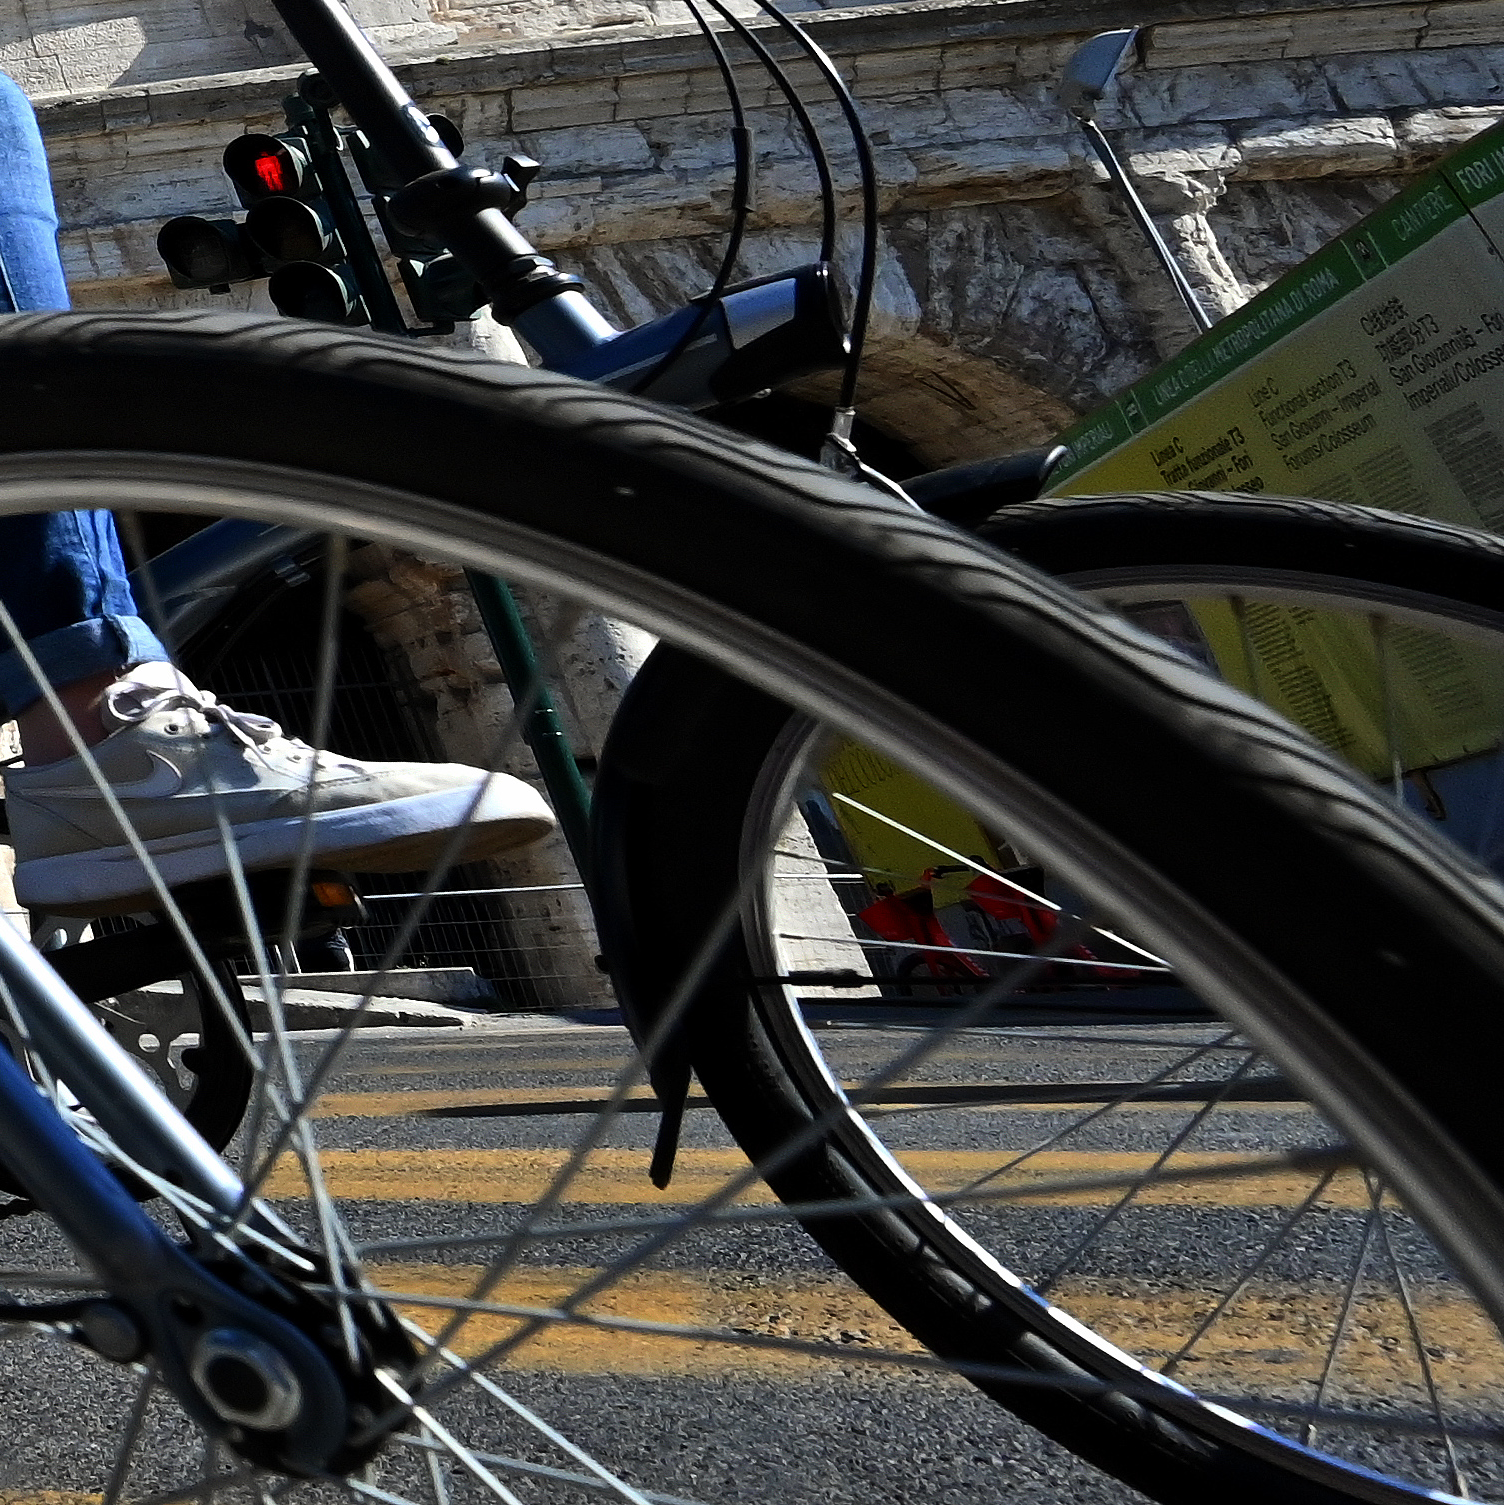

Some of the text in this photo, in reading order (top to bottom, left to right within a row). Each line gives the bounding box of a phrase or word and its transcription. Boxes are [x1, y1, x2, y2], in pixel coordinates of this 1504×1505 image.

[1455, 157, 1497, 195] FORI
[1302, 266, 1341, 304] ROMA
[1336, 359, 1357, 381] T3
[1389, 364, 1417, 387] San
[1173, 436, 1184, 453] C
[1227, 426, 1246, 447] T3
[1271, 429, 1292, 450] San
[1231, 449, 1254, 474] Fori
